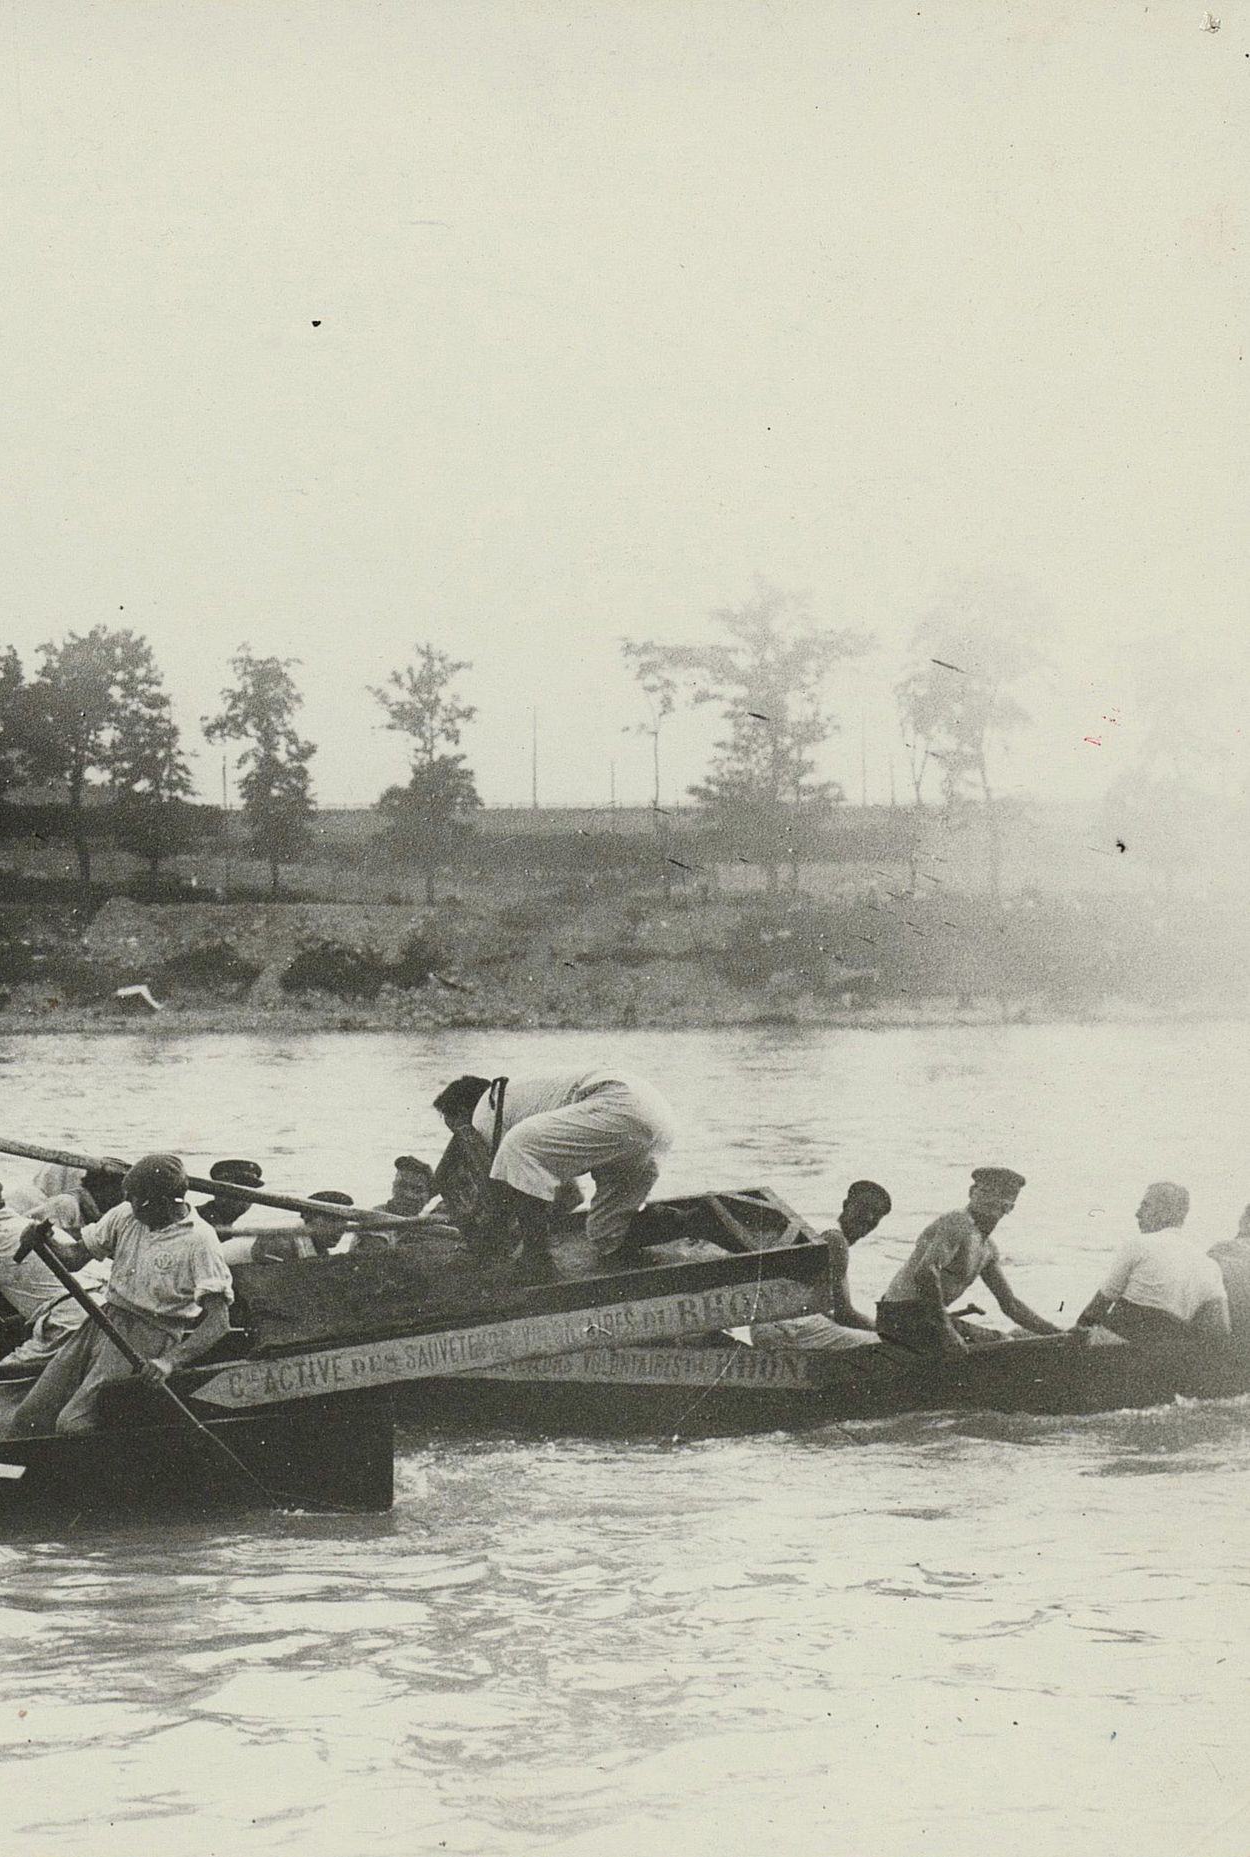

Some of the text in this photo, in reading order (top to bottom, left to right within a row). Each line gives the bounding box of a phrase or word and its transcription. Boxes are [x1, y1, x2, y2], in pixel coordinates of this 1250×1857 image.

[263, 1355, 345, 1395] ACTIVE
[676, 1284, 793, 1326] RHO
[715, 1352, 820, 1381] RHON
